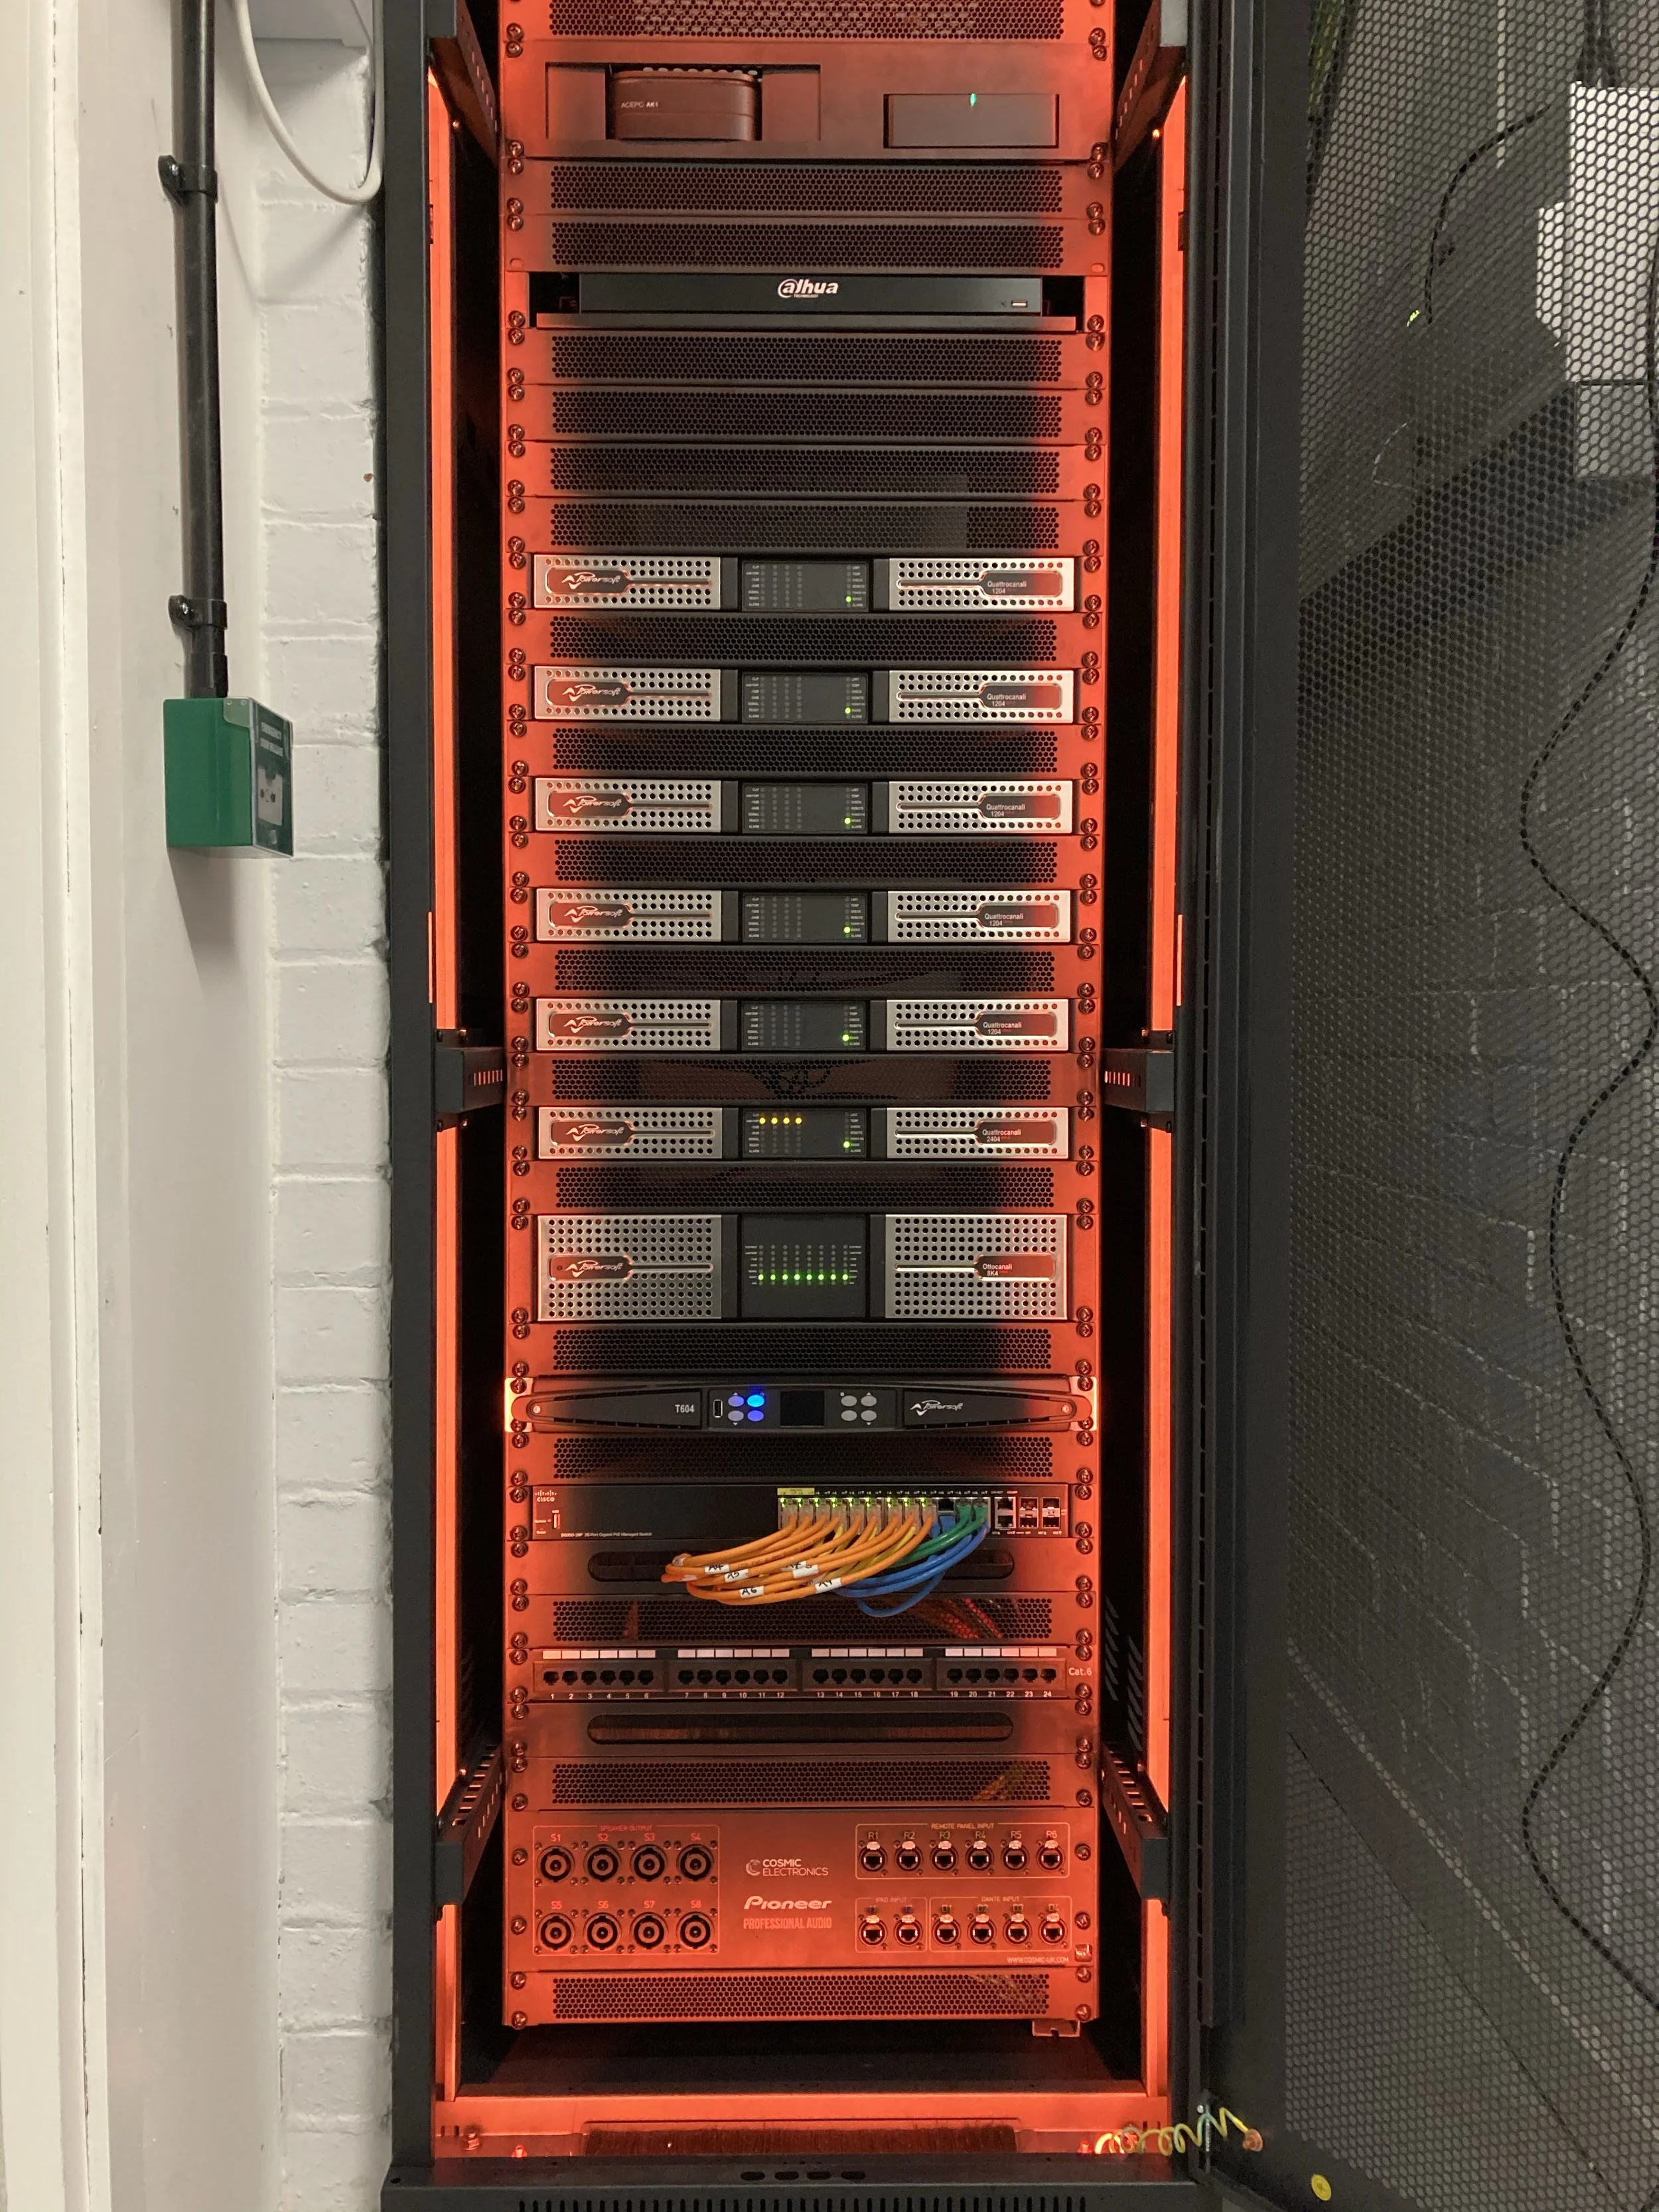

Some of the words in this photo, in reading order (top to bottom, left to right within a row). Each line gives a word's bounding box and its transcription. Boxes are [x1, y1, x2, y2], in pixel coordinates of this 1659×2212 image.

[675, 1404, 695, 1413] T604
[1068, 1667, 1092, 1676] Cat.6
[690, 1832, 701, 1841] S4
[1010, 1830, 1022, 1839] R5
[762, 1867, 829, 1876] ELECTRONICS
[551, 1901, 563, 1909] S5
[644, 1900, 656, 1909] S7
[744, 1895, 832, 1909] Pioneer
[743, 1917, 805, 1929] PROFESSIONAL
[806, 1917, 832, 1929] AUDIO
